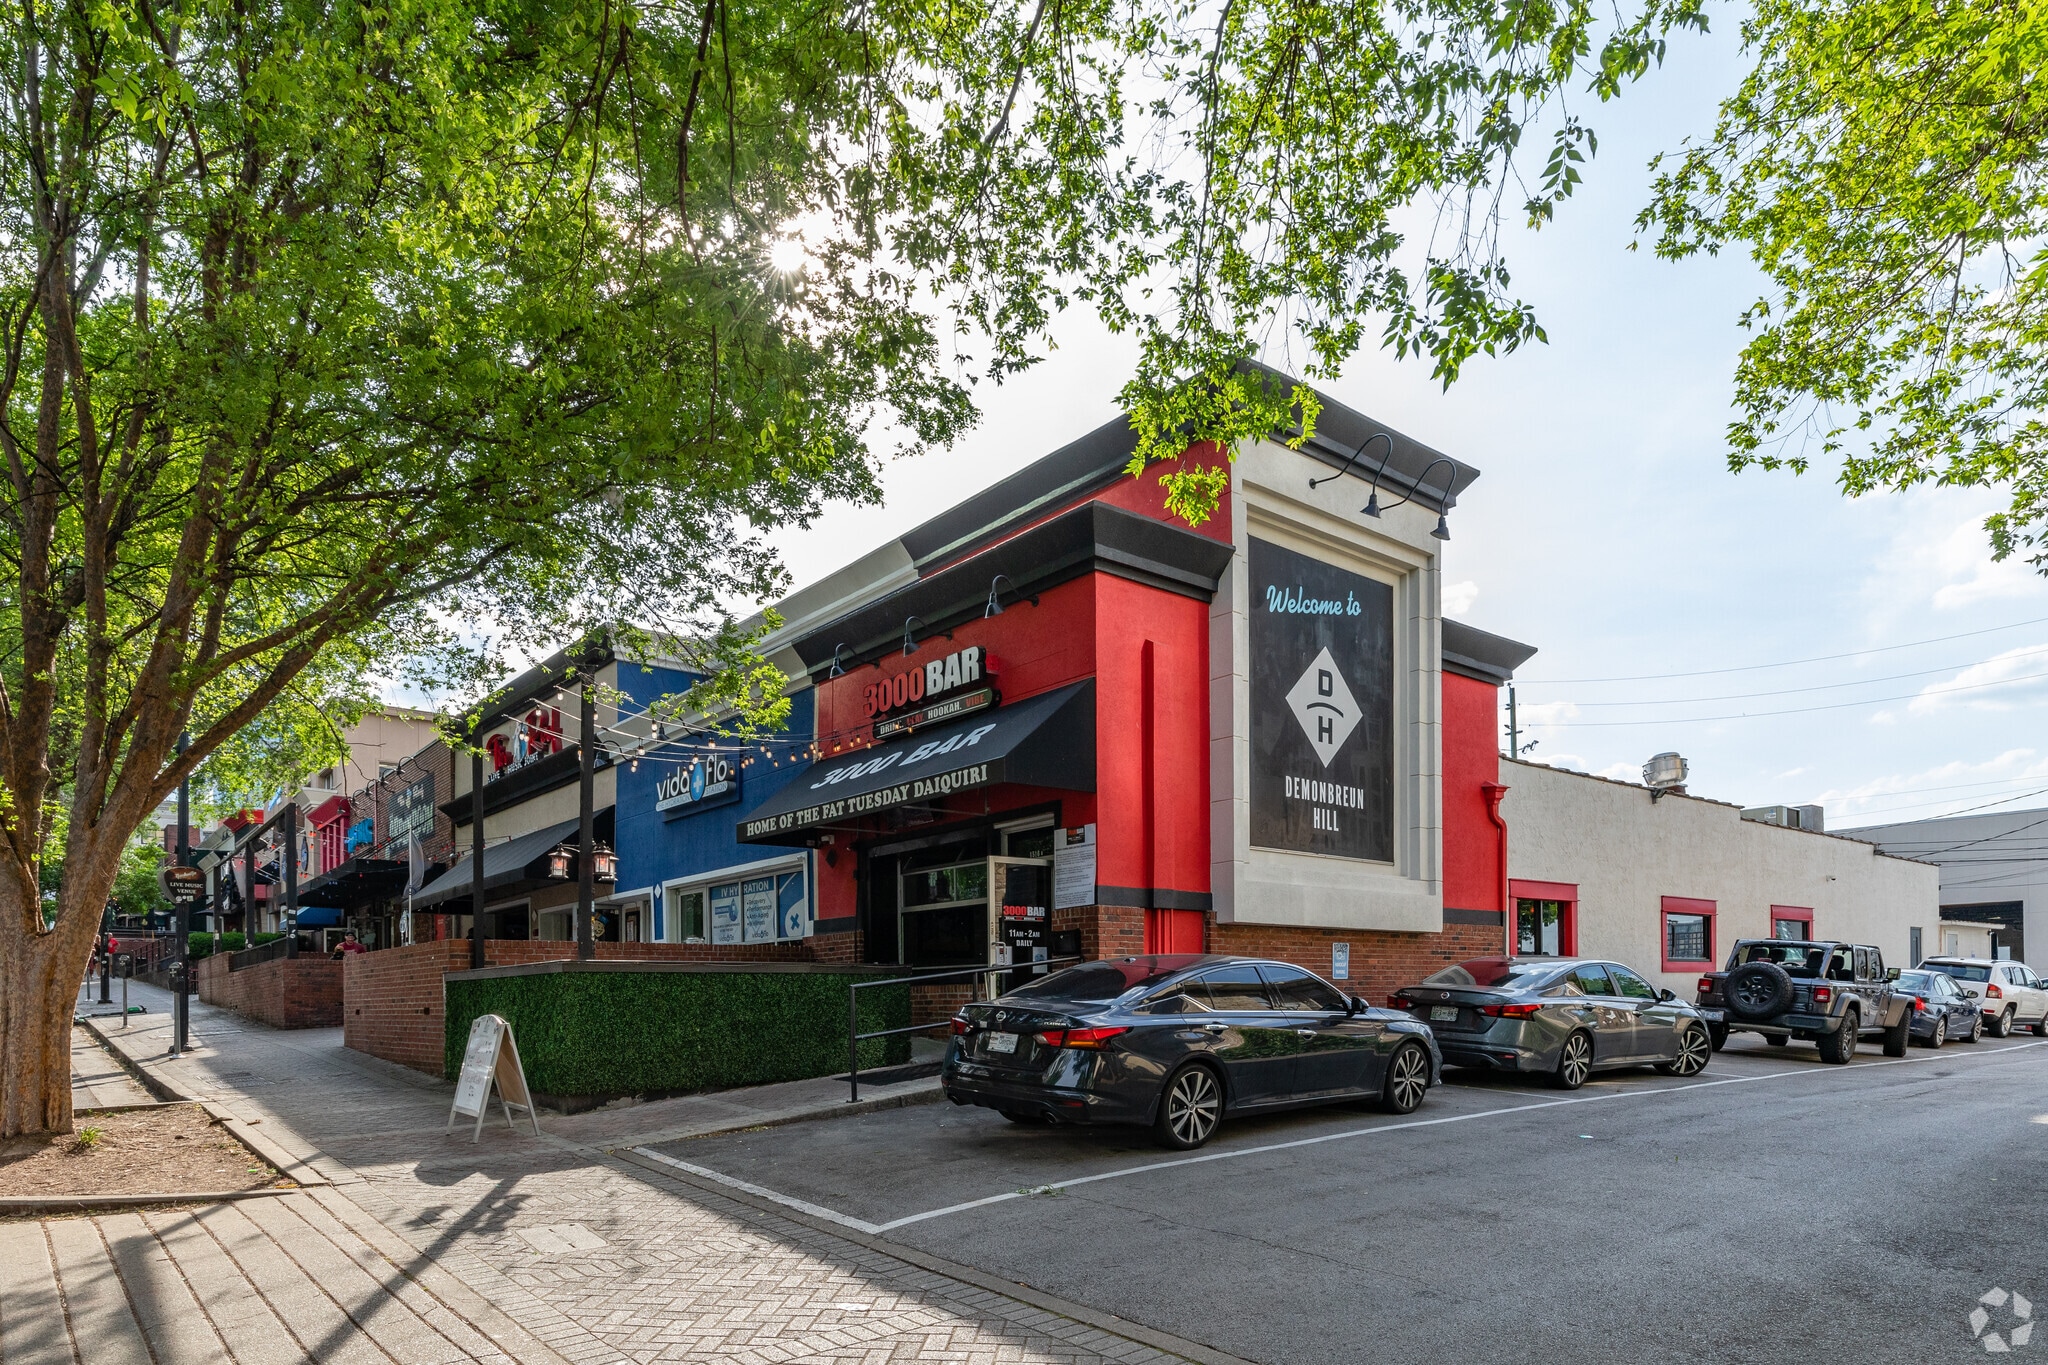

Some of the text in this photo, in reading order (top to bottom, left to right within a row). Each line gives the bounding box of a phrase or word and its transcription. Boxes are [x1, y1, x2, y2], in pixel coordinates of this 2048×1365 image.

[1266, 584, 1362, 617] Welcome to
[1318, 668, 1334, 697] D
[927, 701, 962, 719] HOOKAH.
[1318, 715, 1334, 744] H
[810, 723, 997, 789] 3000 BAR
[746, 764, 988, 837] HOME OF THE FAT TUESDAY DAIQUIRI
[1285, 775, 1364, 810] DEMONBREUN
[1313, 807, 1339, 832] HILL
